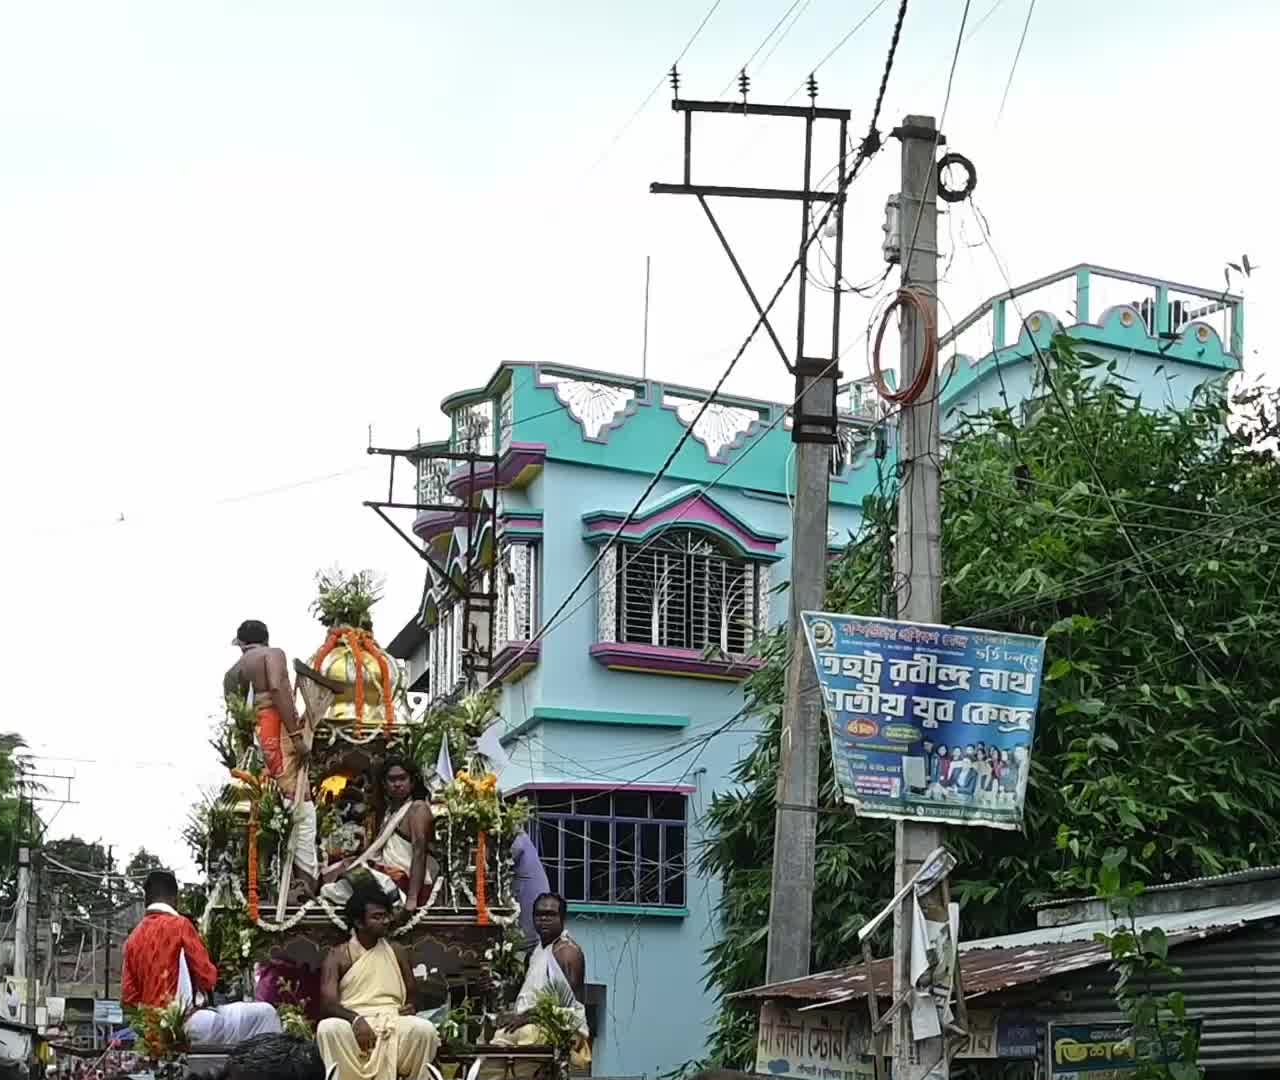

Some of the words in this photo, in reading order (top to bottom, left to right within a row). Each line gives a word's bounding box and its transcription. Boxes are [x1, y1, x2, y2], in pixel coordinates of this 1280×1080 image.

[889, 654, 974, 691] রবীন্দ্র
[979, 668, 1035, 696] নাথ
[913, 698, 956, 729] যুব
[962, 702, 1036, 733] কেন্দ্র
